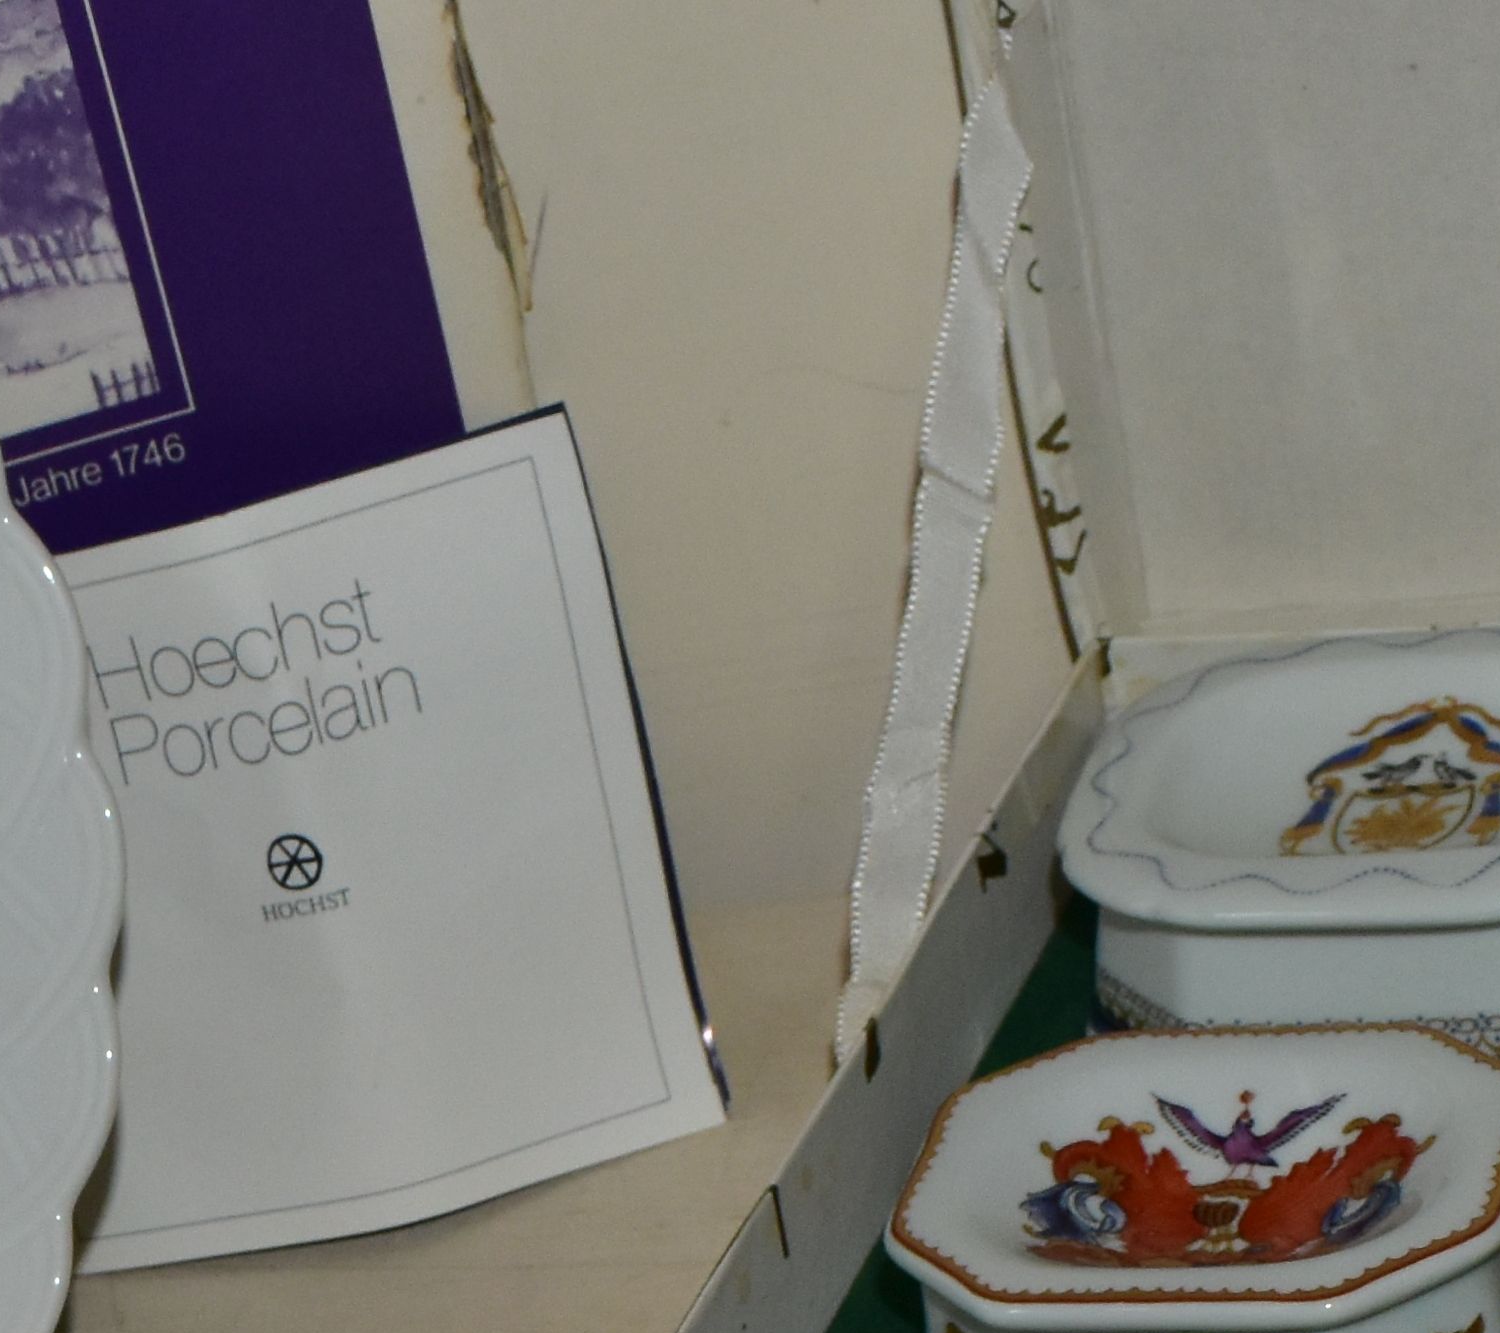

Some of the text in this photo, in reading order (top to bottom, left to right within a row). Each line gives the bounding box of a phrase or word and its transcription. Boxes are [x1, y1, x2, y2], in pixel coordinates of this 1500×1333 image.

[15, 432, 186, 507] Jahre 1746
[85, 579, 382, 709] Hoechst
[109, 660, 423, 785] Porcelain
